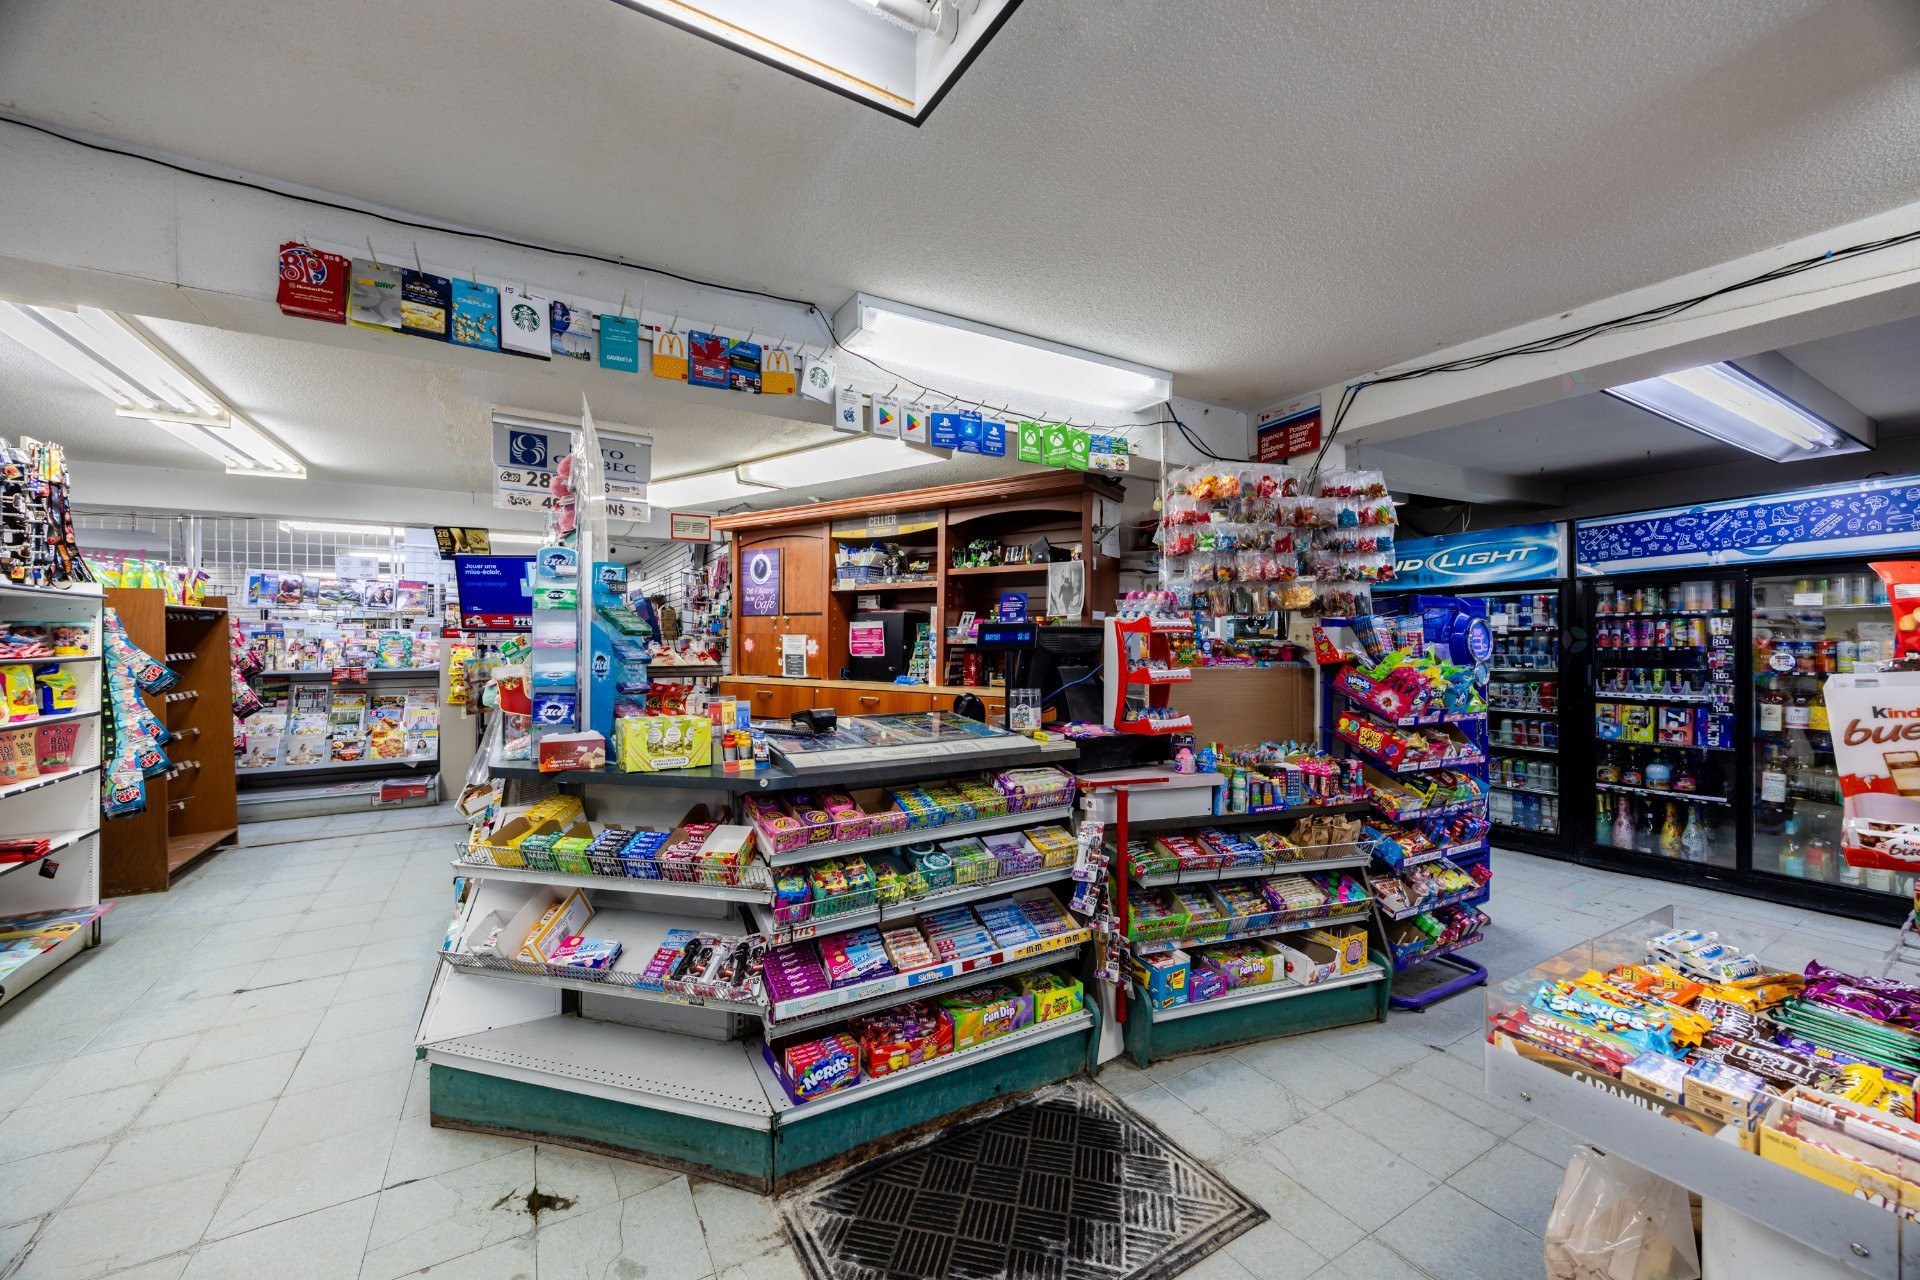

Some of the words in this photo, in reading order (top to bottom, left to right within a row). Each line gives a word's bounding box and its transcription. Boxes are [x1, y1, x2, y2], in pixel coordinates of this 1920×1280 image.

[356, 278, 396, 290] SUBWAY
[405, 283, 439, 295] CINEPLEX
[505, 286, 514, 294] 15
[457, 297, 493, 309] CINEPLEX
[1289, 422, 1315, 434] Postage
[1261, 431, 1284, 443] Agence
[1289, 429, 1309, 440] stamp
[1289, 436, 1306, 445] sales
[1261, 443, 1286, 454] timbres-
[1289, 441, 1312, 452] agency
[1261, 450, 1279, 462] poste
[868, 514, 896, 528] CELLIER
[543, 555, 573, 566] excel
[1439, 546, 1539, 568] LIGHT
[600, 570, 622, 581] excel
[514, 617, 532, 626] 225
[592, 656, 610, 671] excel
[540, 704, 569, 717] excel
[51, 736, 69, 745] BON
[1360, 728, 1383, 741] Ring
[51, 743, 70, 751] BON
[627, 860, 651, 868] HALLS
[1138, 923, 1157, 932] CRY
[1158, 921, 1180, 929] BABY
[572, 952, 595, 961] Original
[857, 959, 878, 972] Original
[1240, 966, 1253, 977] Fun
[1252, 962, 1266, 974] Dip
[1730, 961, 1760, 977] BOUNTY
[984, 1012, 1000, 1026] Fun
[999, 1006, 1015, 1020] Dip
[1550, 995, 1648, 1031] Skittles
[1571, 1070, 1666, 1116] CARAMILK
